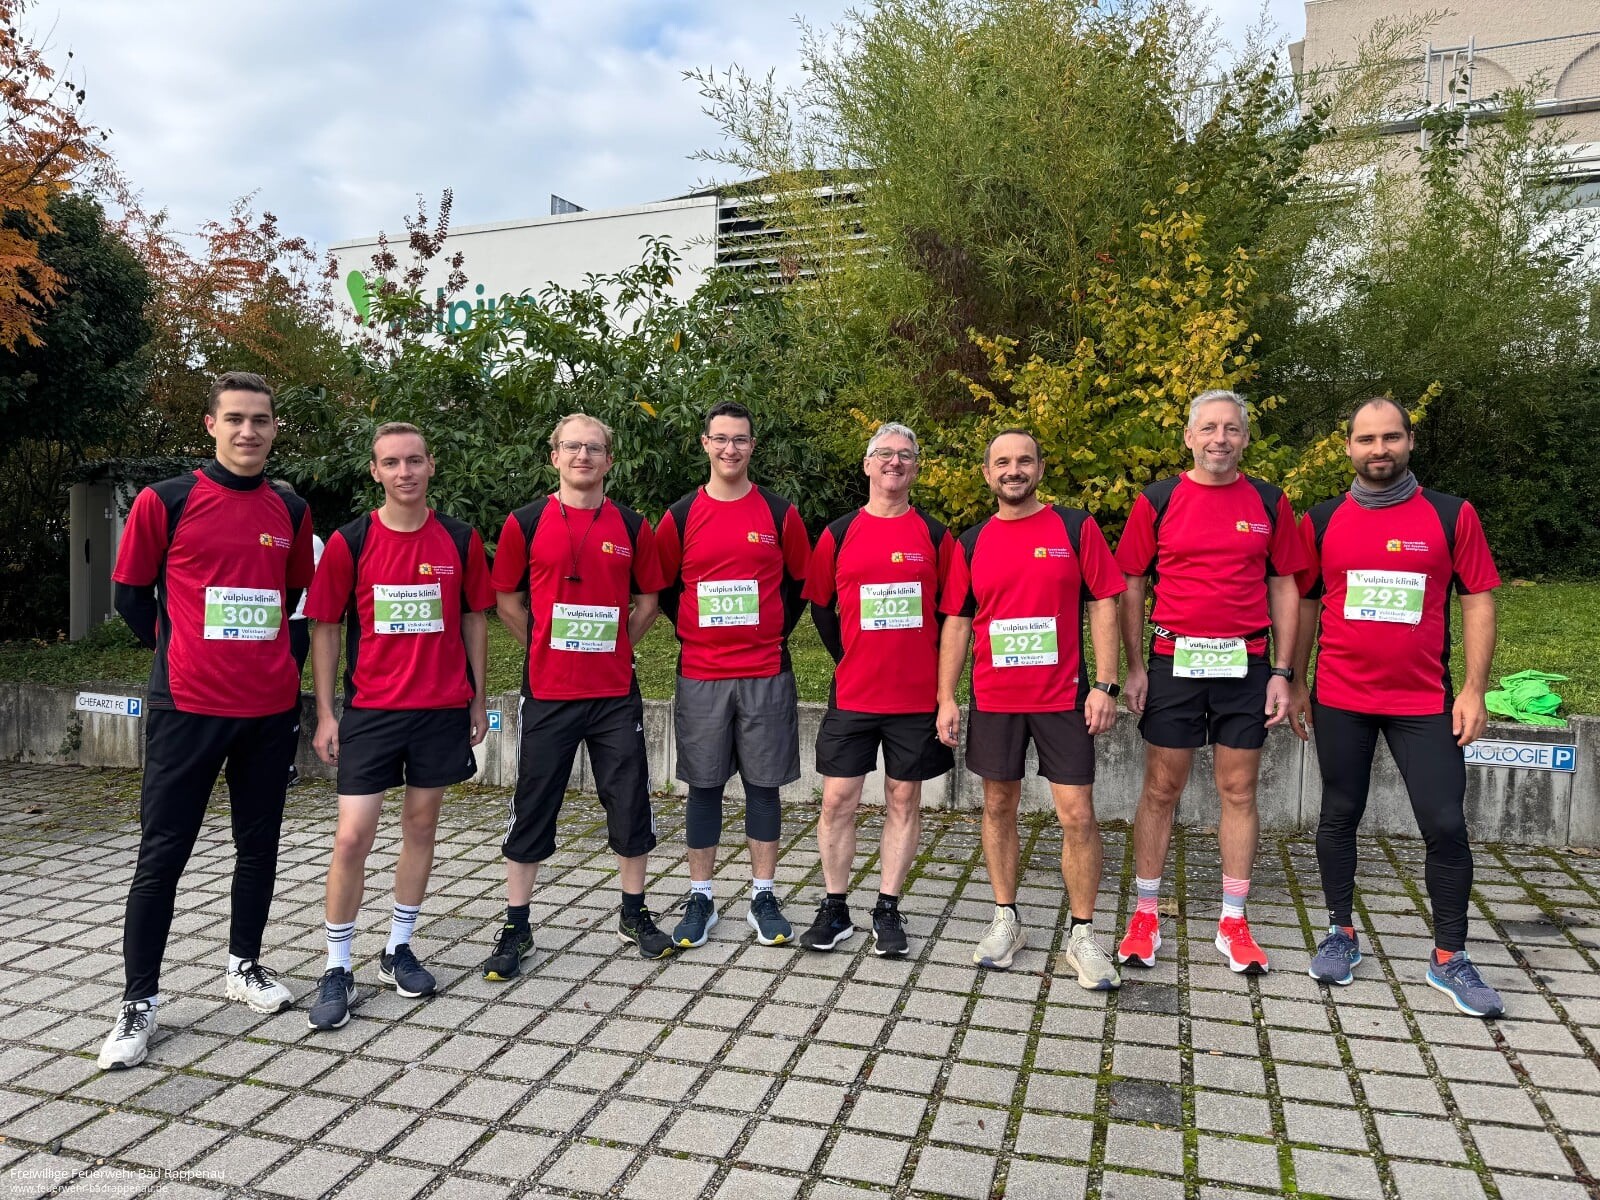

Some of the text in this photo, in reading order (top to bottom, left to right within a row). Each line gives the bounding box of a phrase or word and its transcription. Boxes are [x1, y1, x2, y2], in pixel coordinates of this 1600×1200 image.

[708, 584, 753, 594] vulpius klinik
[1363, 575, 1419, 587] vulpius klinik
[222, 593, 277, 603] vulpius klinik
[388, 589, 437, 600] vulpius klinik
[872, 587, 916, 597] vulpius klinik
[1361, 588, 1408, 608] 293
[389, 602, 432, 620] 298
[710, 596, 744, 613] 301
[873, 599, 909, 616] 302
[223, 606, 268, 625] 300
[567, 610, 614, 619] vulpius klinik
[566, 621, 606, 639] 297
[1002, 622, 1050, 633] vulpius klinik
[1003, 634, 1043, 653] 292
[1189, 640, 1239, 650] vulpius klinik
[1189, 652, 1233, 668] 299
[79, 696, 114, 709] CHEFARZT
[130, 700, 138, 714] P
[1555, 749, 1571, 766] P
